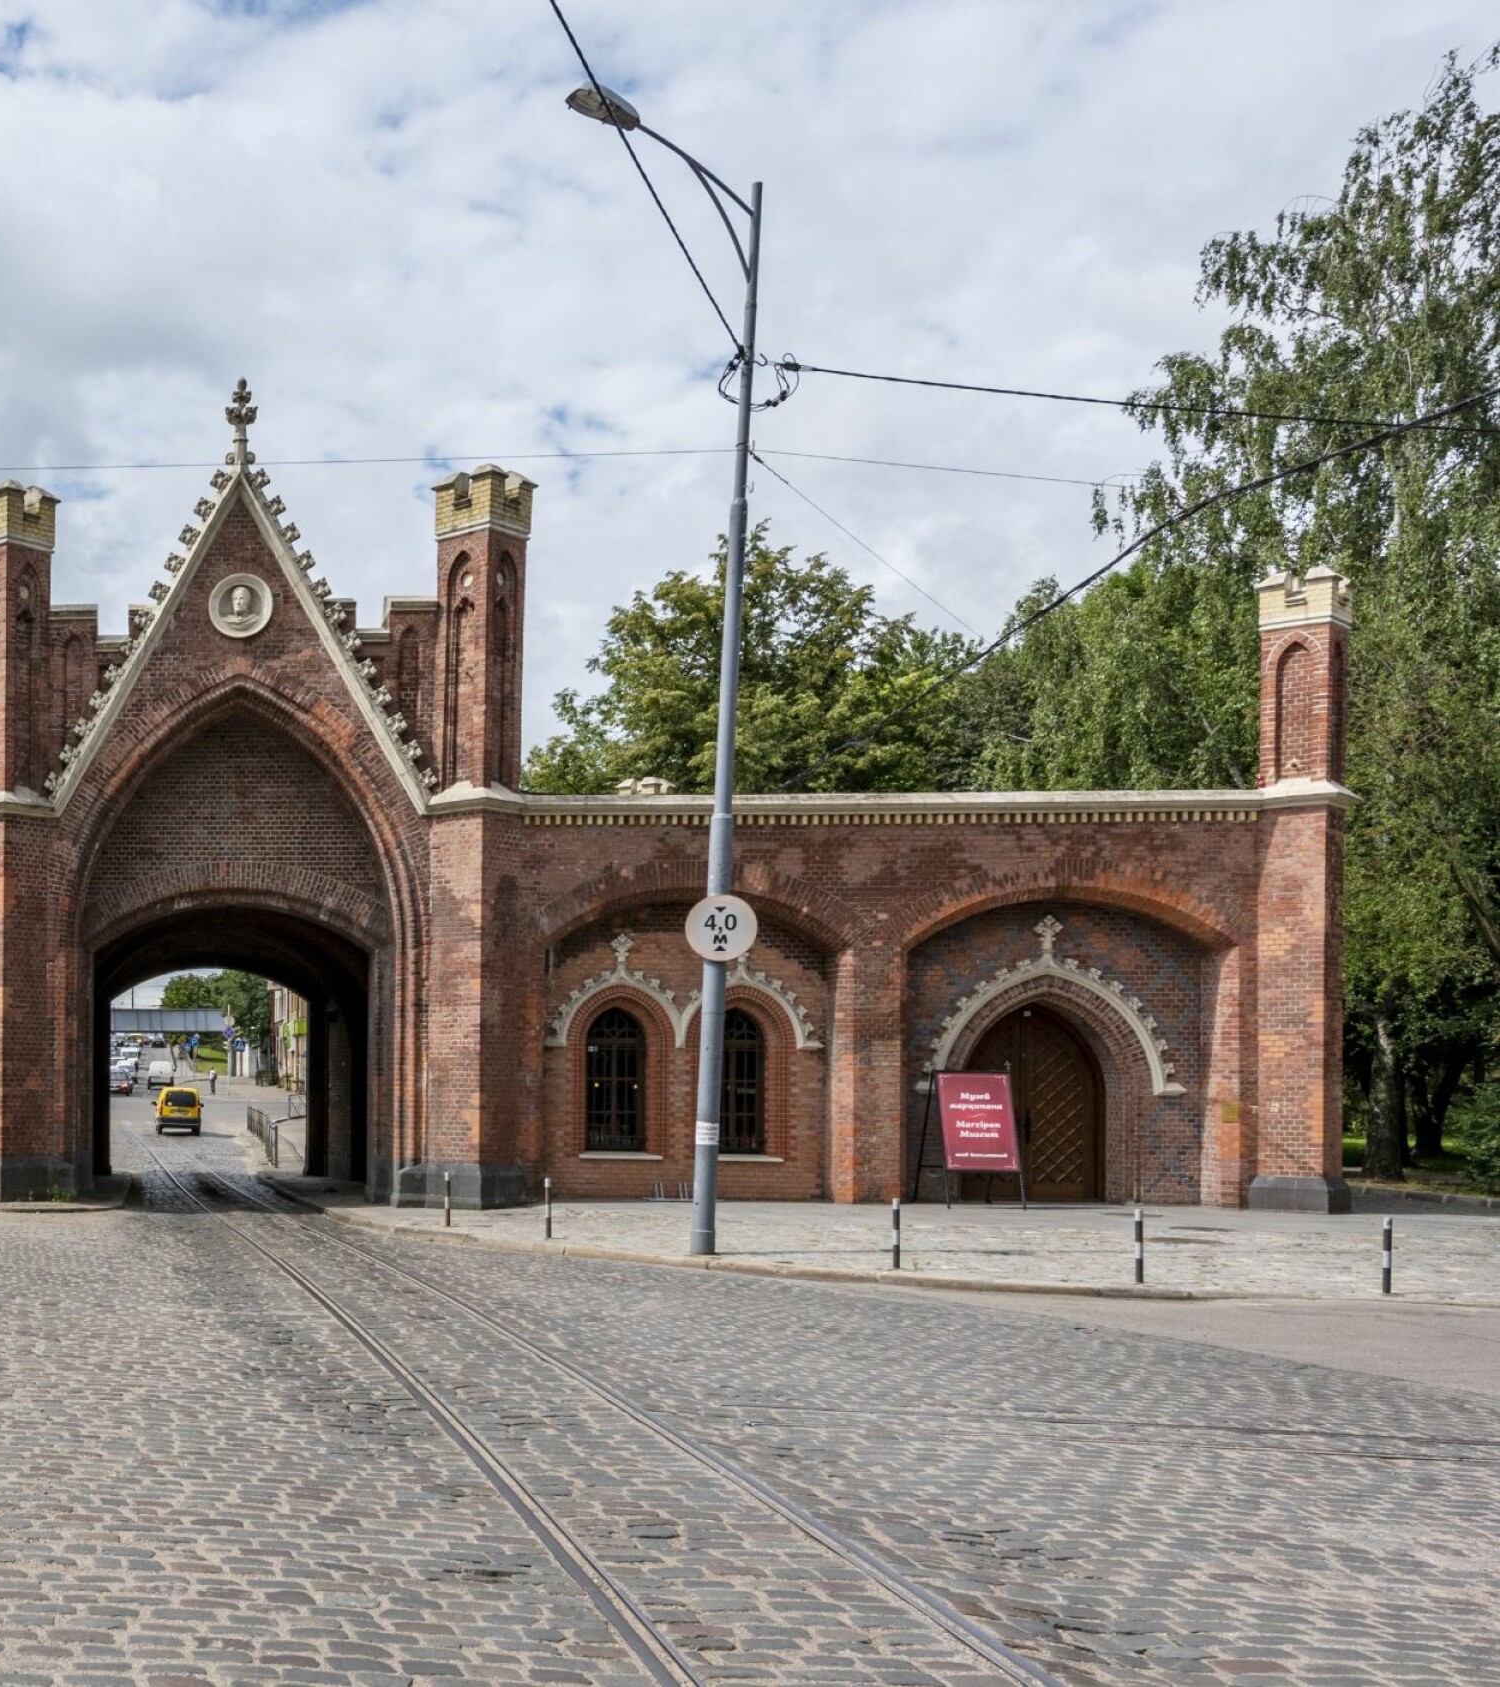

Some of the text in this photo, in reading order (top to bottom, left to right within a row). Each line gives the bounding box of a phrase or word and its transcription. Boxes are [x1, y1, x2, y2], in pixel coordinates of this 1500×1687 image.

[704, 914, 737, 934] 4,0
[960, 1092, 990, 1101] Музей
[956, 1121, 1001, 1130] Marzipan
